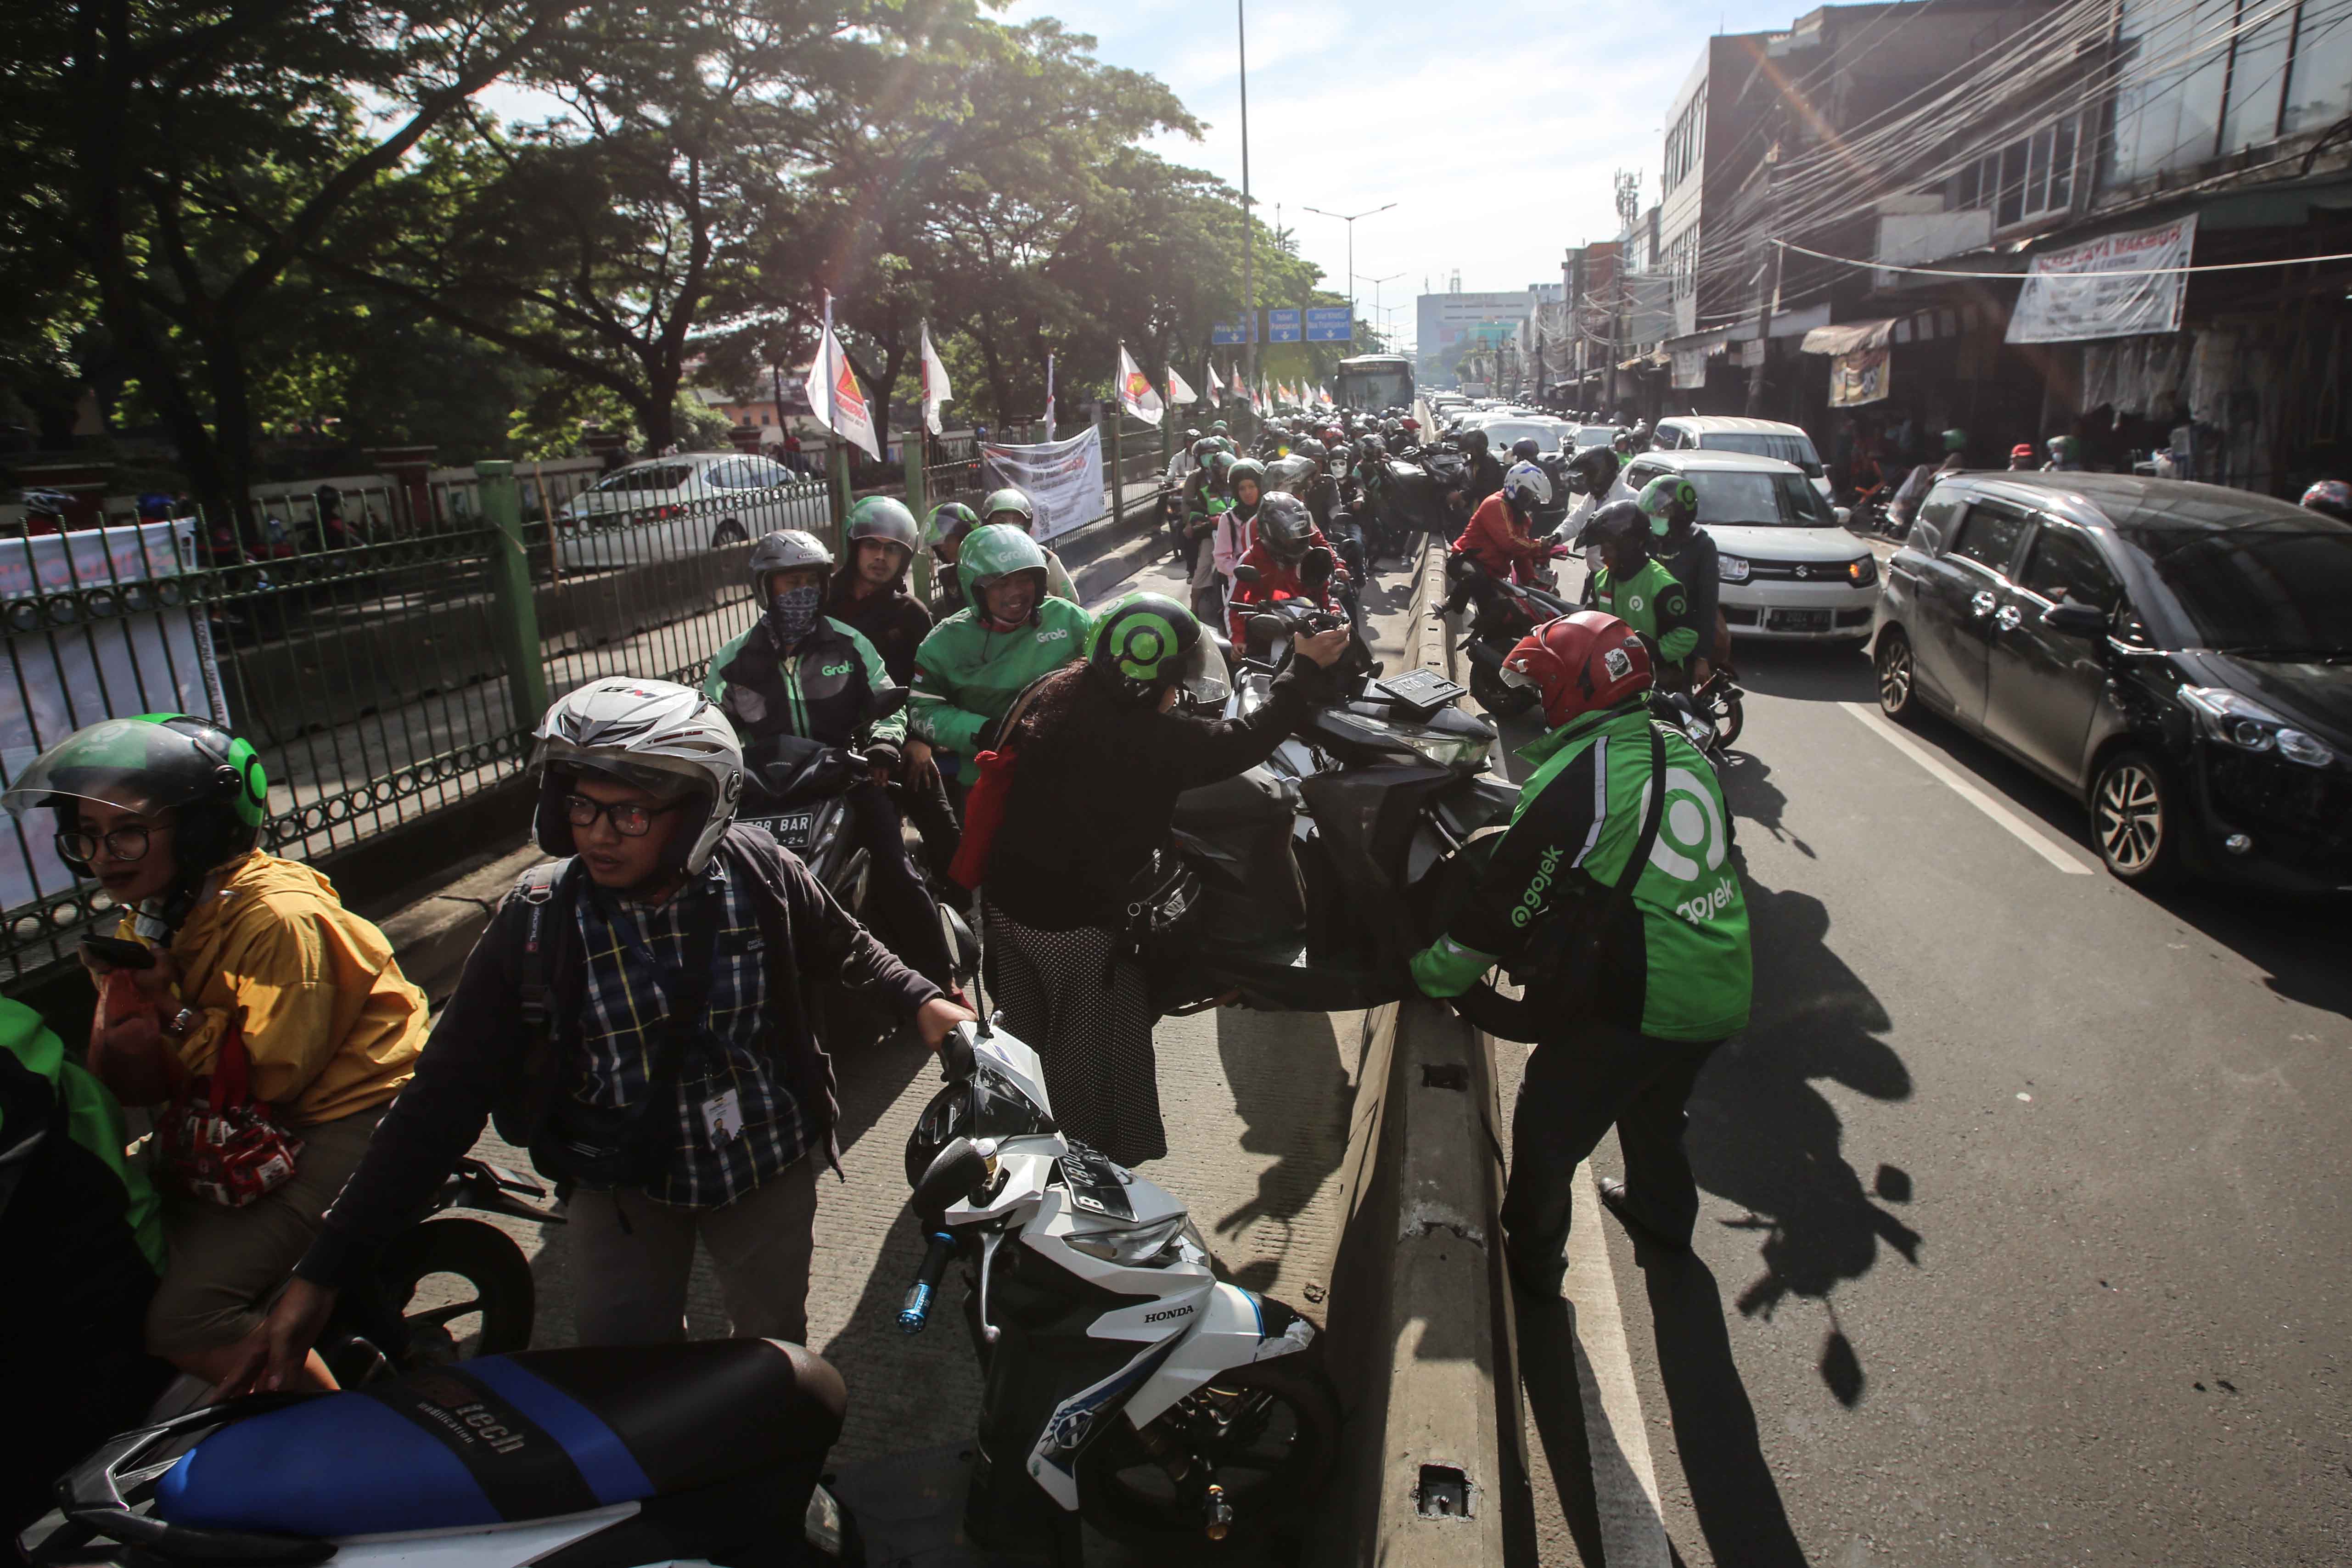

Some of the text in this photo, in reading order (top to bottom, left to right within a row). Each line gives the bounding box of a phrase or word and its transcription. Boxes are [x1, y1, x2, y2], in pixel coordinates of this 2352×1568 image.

[1036, 628, 1067, 643] Grab
[822, 660, 854, 676] Grab
[1387, 685, 1404, 694] B
[780, 817, 808, 832] BAR
[1524, 844, 1564, 909] gojek
[1676, 877, 1734, 925] gojek
[1079, 1196, 1105, 1210] B
[1144, 1304, 1194, 1323] HONDA
[456, 1404, 525, 1454] tech
